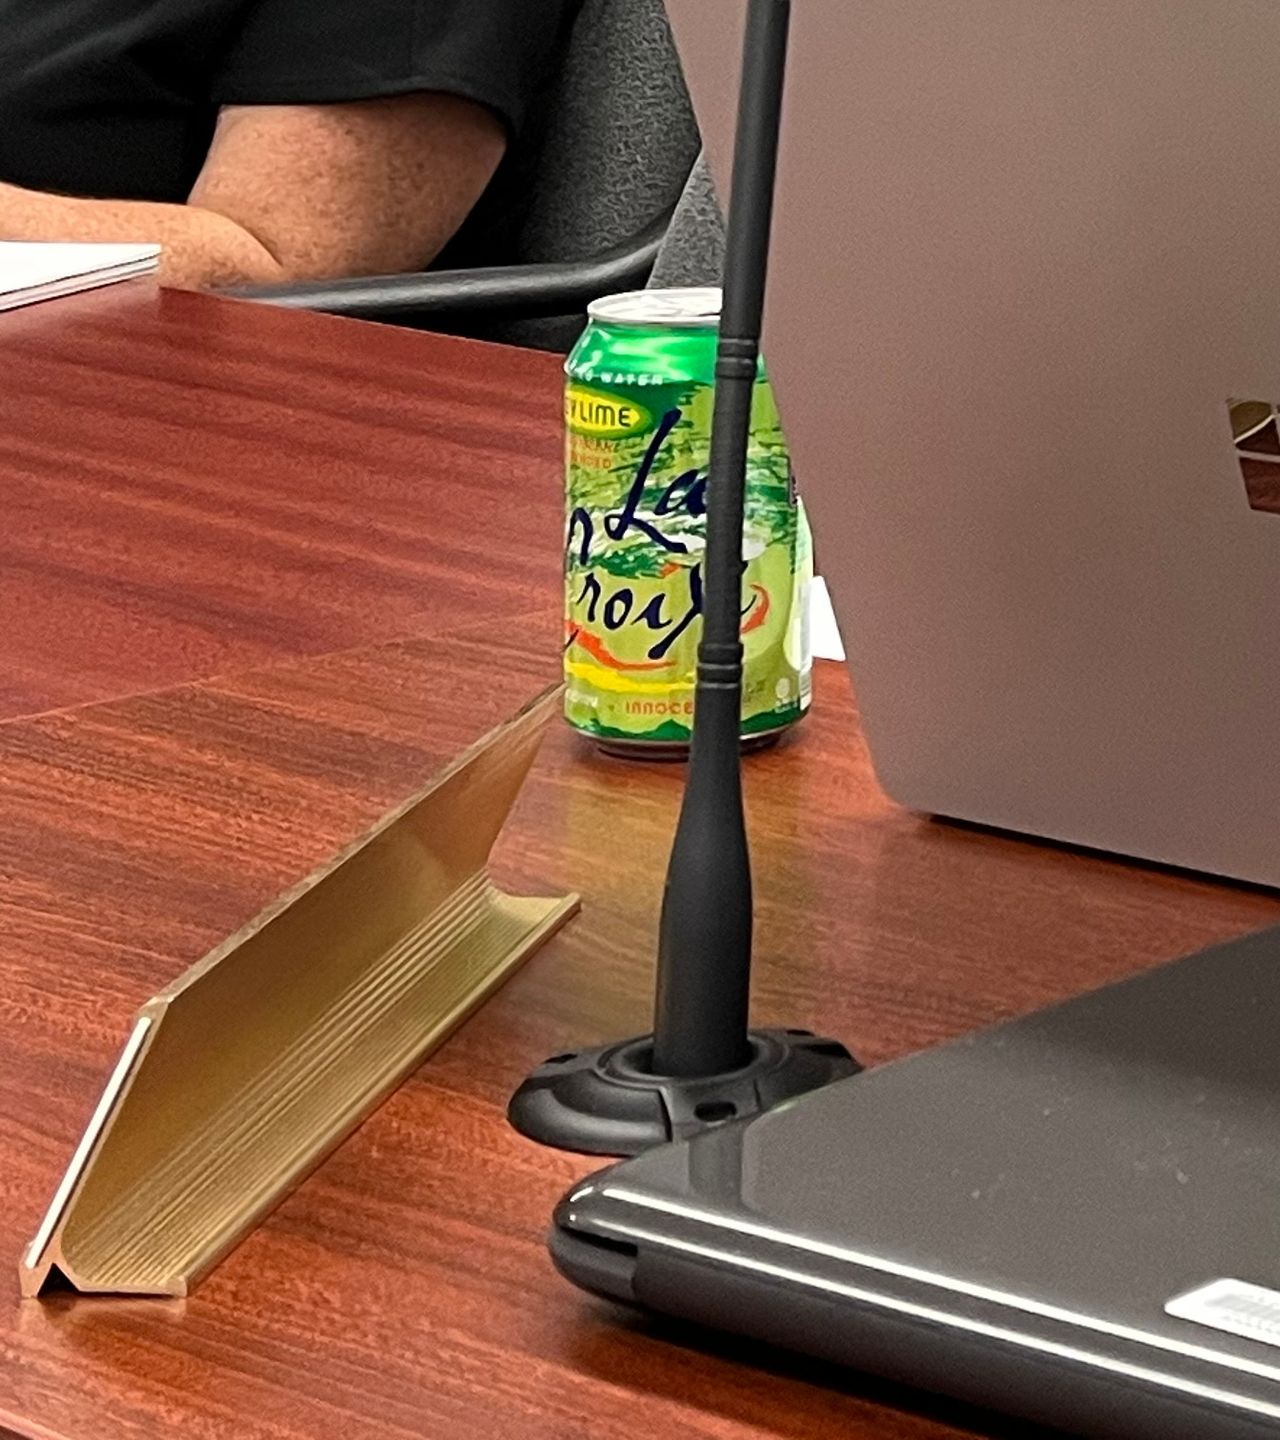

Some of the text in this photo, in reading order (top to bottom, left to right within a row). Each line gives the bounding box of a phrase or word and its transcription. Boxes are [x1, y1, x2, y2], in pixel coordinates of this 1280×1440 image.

[580, 401, 632, 427] LIME
[604, 408, 709, 554] La
[625, 700, 694, 716] INNOCE
